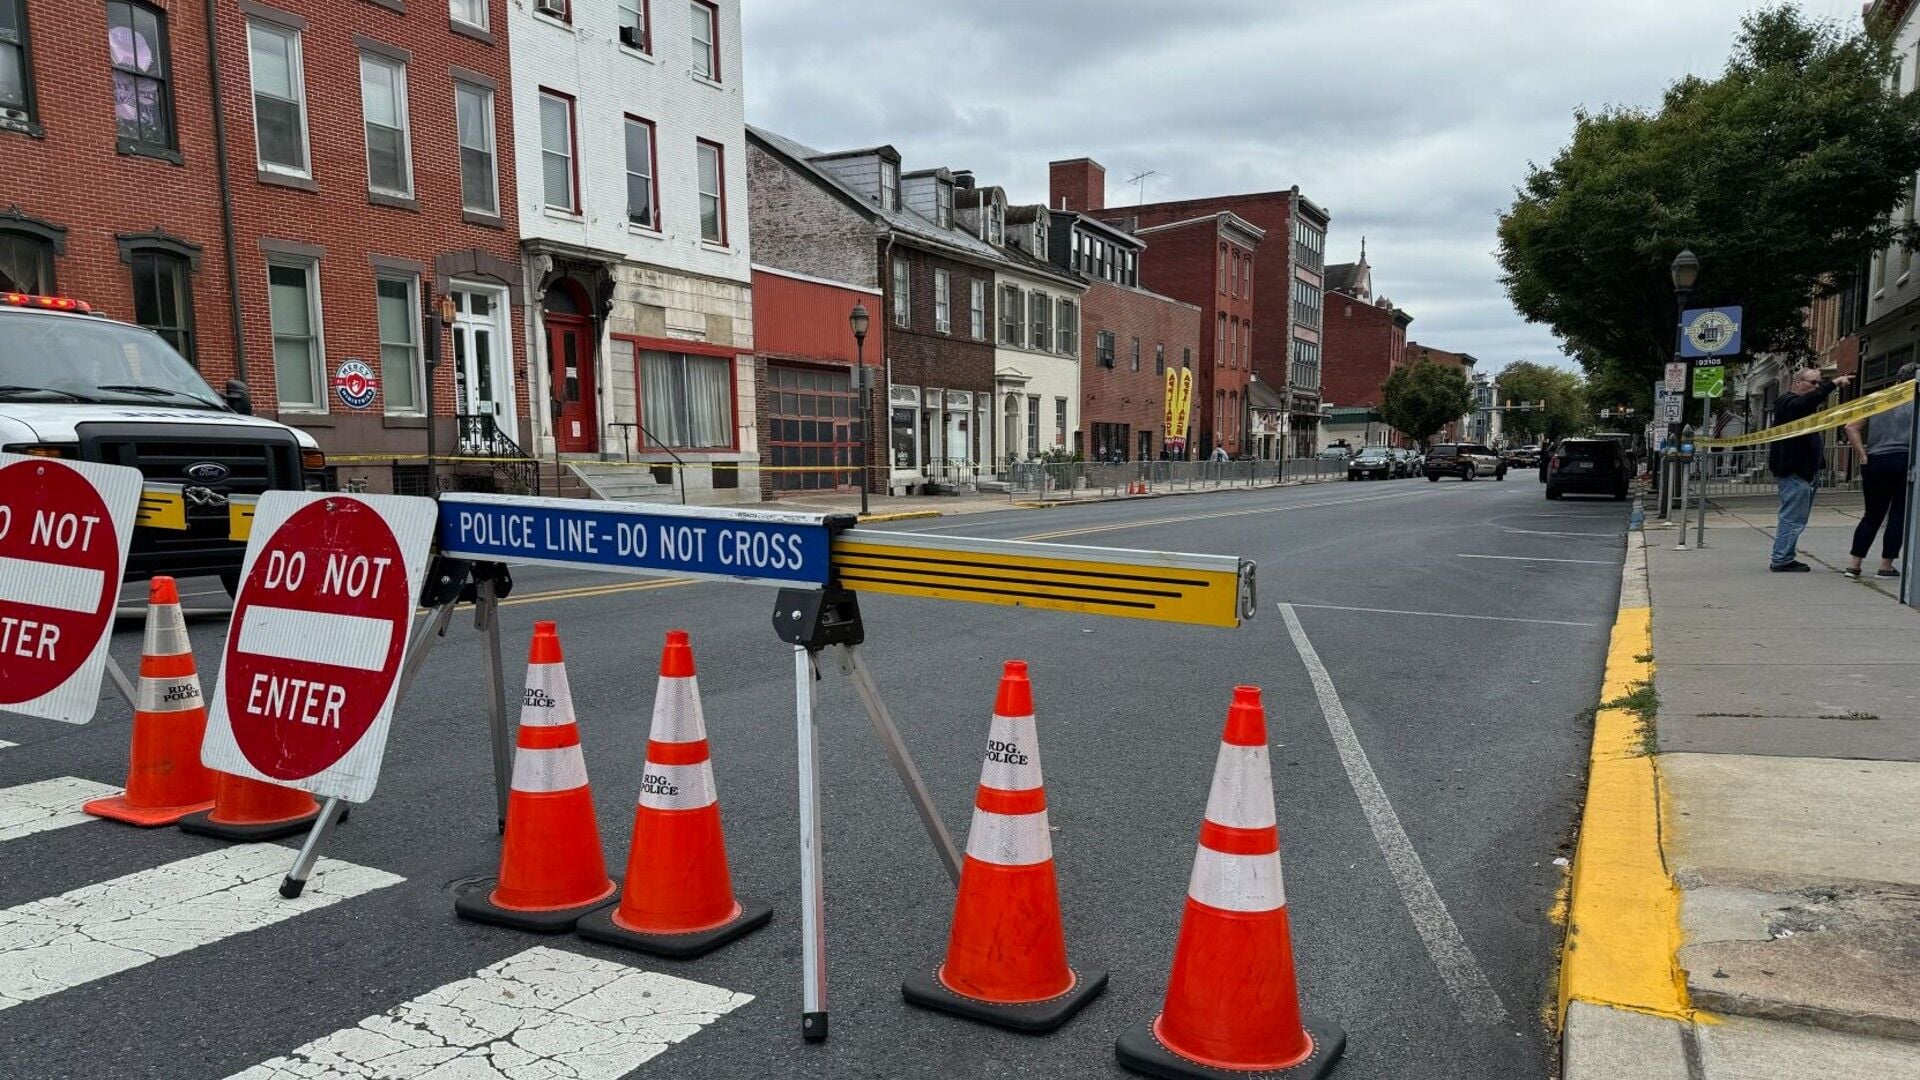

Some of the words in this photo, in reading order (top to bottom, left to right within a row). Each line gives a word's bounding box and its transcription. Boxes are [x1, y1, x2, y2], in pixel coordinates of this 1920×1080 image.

[342, 363, 370, 376] MERCY
[0, 505, 11, 540] O
[30, 510, 100, 551] NOT
[460, 512, 536, 548] POLICE
[660, 525, 707, 562] NOT
[718, 529, 803, 570] CROSS
[264, 550, 306, 591] DO
[322, 553, 392, 599] NOT
[1, 617, 61, 661] TER
[163, 689, 200, 702] POLICE
[526, 688, 549, 698] DG.
[247, 673, 346, 729] ENTER
[522, 697, 556, 708] OLICE
[988, 740, 1021, 754] RDG.
[644, 774, 671, 786] RDG.
